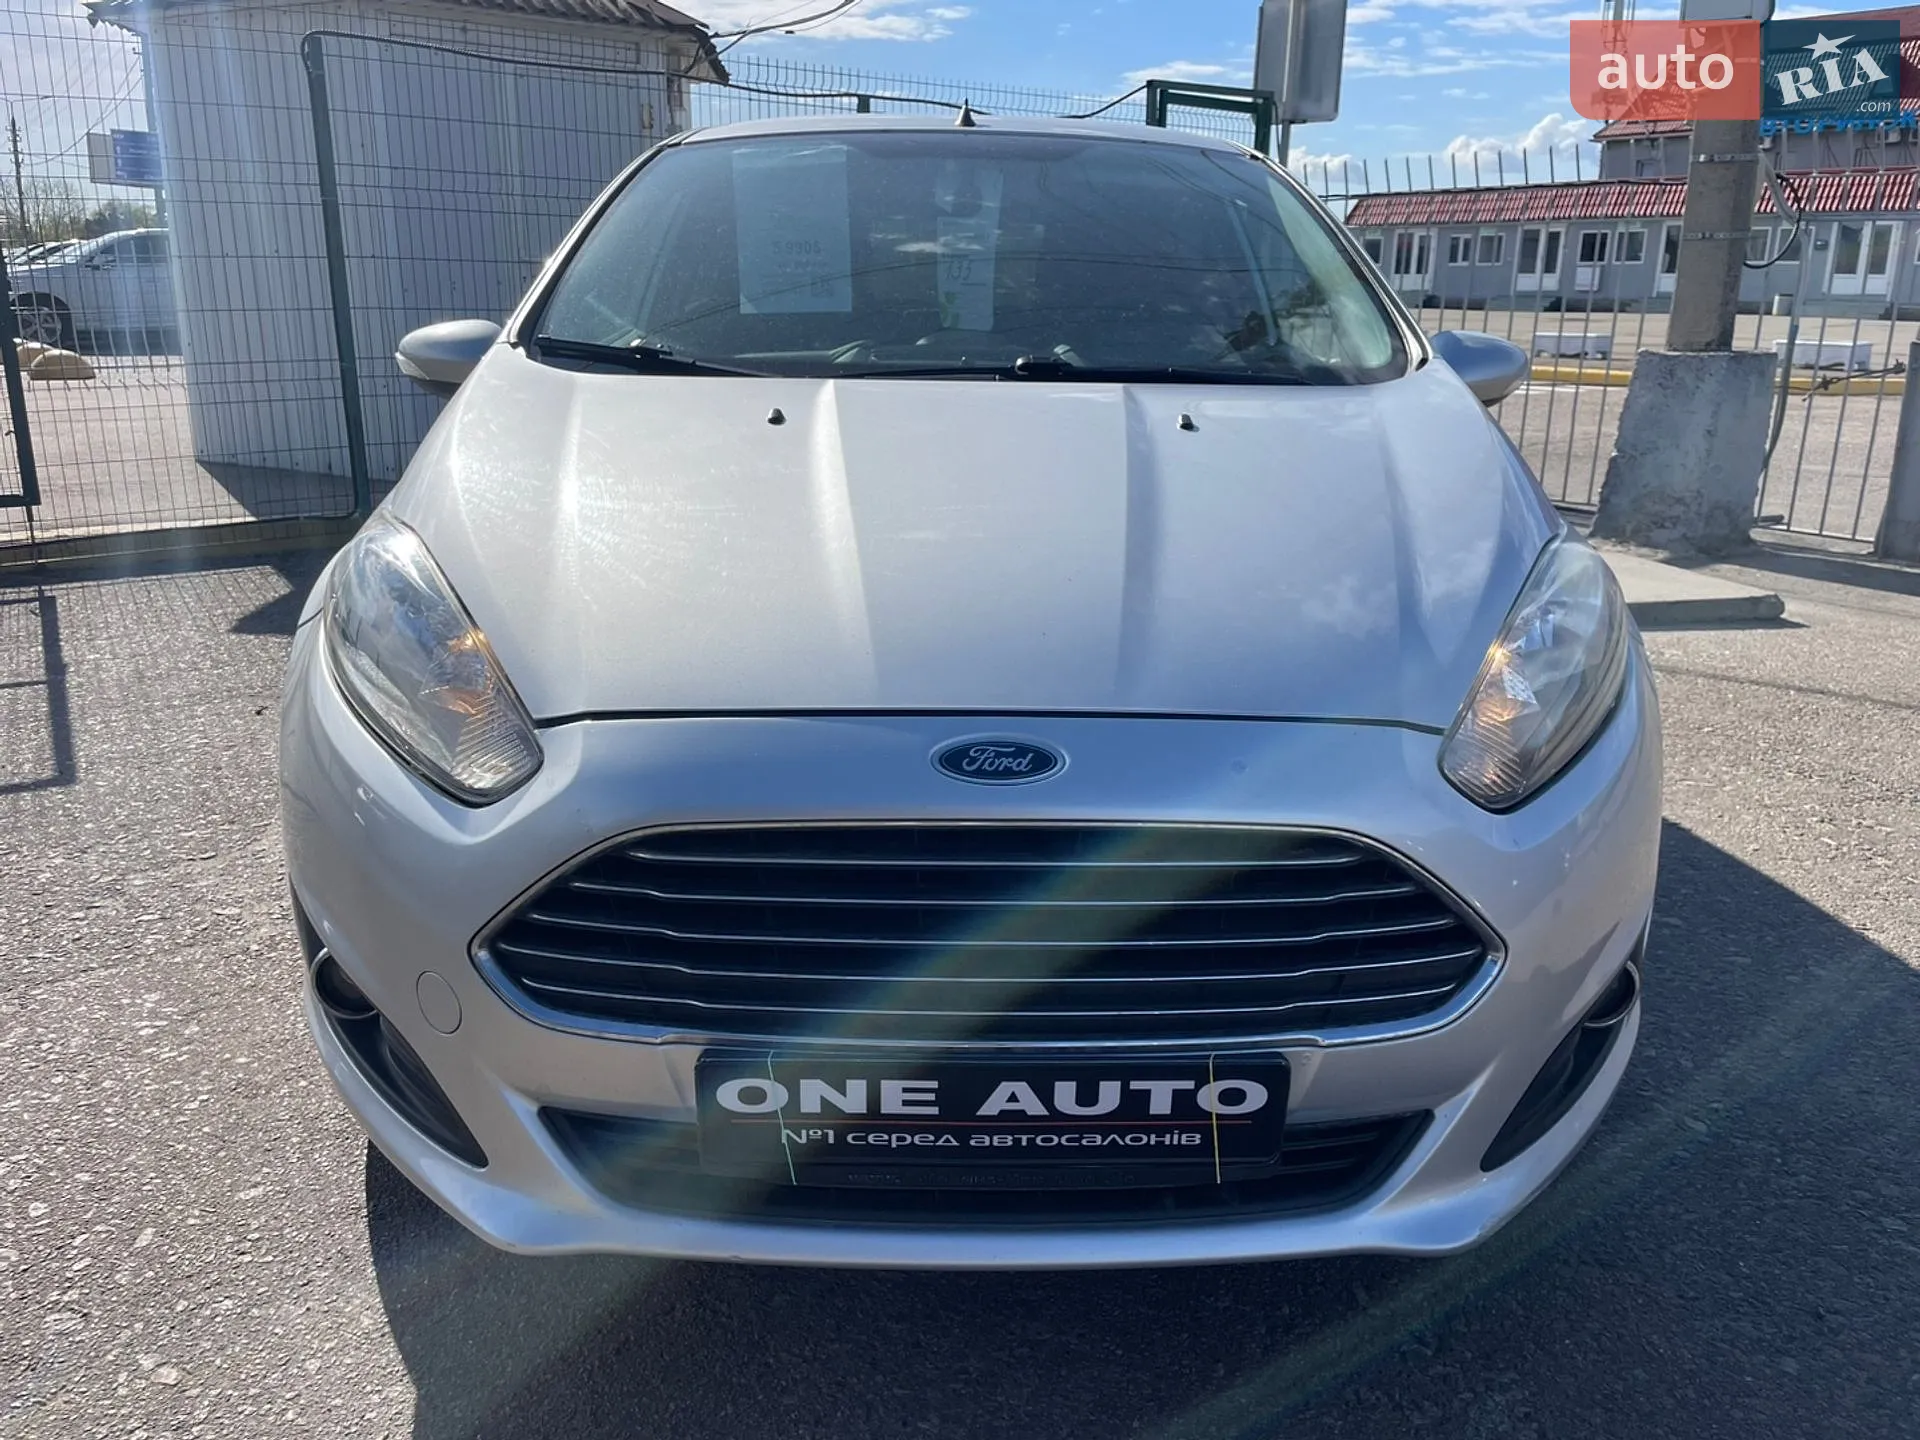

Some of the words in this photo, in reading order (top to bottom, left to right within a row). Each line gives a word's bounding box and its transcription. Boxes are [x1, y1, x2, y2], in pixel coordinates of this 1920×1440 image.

[962, 745, 1034, 771] Ford
[715, 1078, 940, 1115] ONE
[976, 1079, 1269, 1116] AUTO
[846, 1132, 960, 1149] серед
[969, 1130, 1202, 1147] автосалонів
